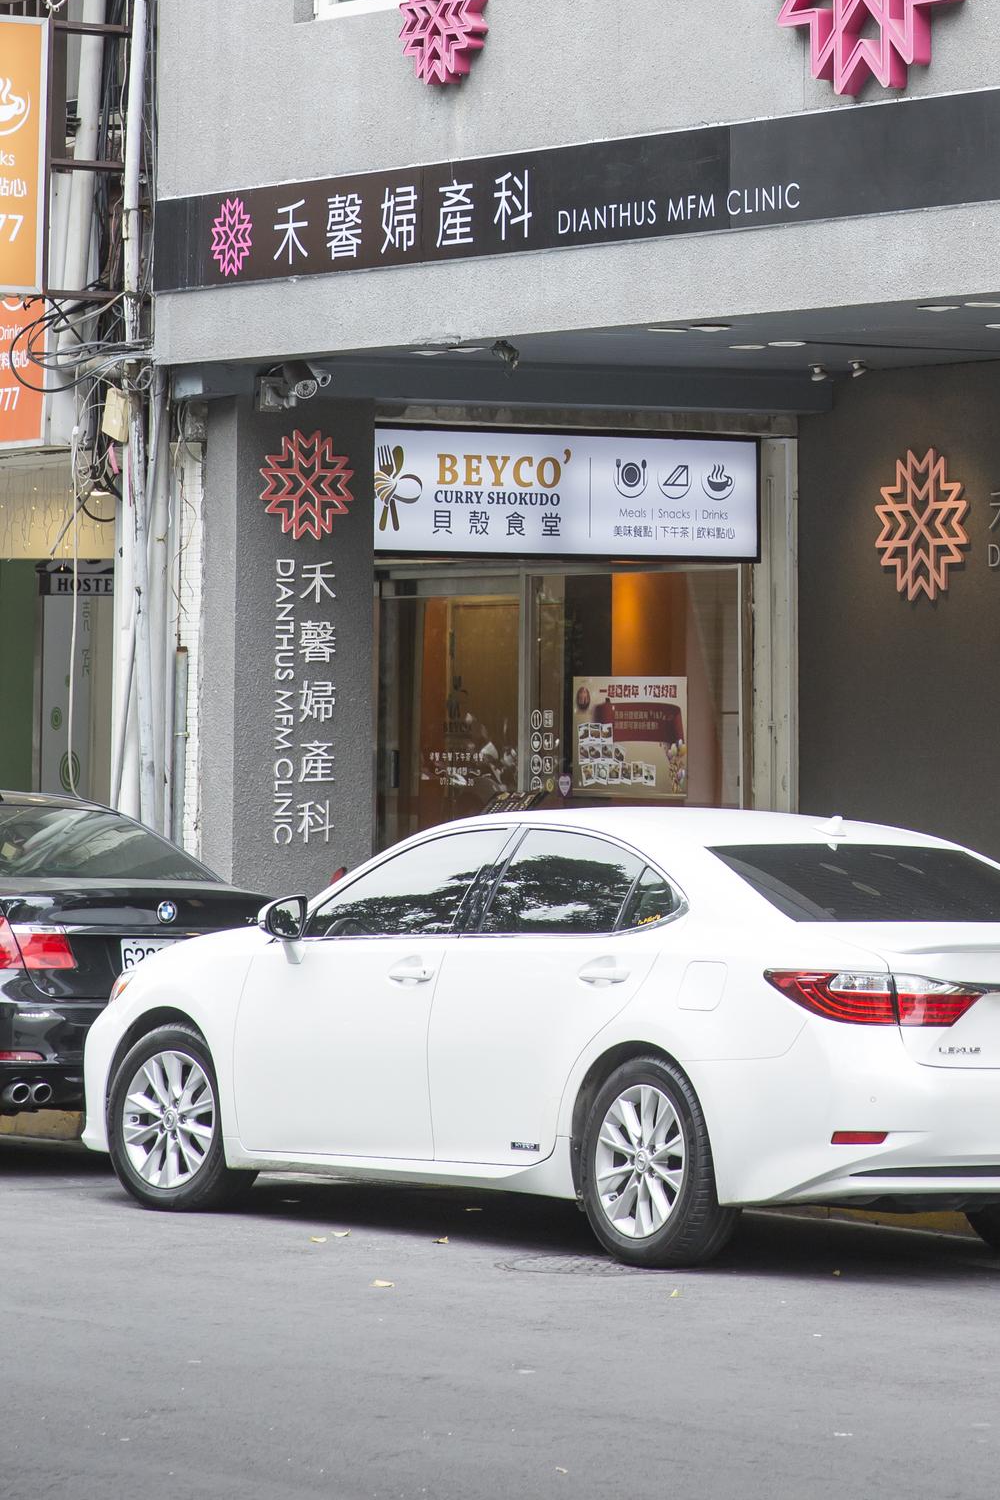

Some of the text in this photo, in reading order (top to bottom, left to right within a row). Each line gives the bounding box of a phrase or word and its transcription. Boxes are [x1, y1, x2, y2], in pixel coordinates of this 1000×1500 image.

[273, 170, 533, 265] 禾馨婦產科
[557, 183, 801, 235] DIANTHUS MFM CLINIC
[434, 489, 561, 506] CURRY SHOKUDO
[619, 508, 729, 520] Meals Snacks Drinks
[432, 510, 562, 537] 貝殼食堂
[660, 526, 689, 538] 下午茶
[273, 559, 296, 845] DIANTHUS MFM CLINIC
[297, 560, 336, 844] 禾馨婦產科
